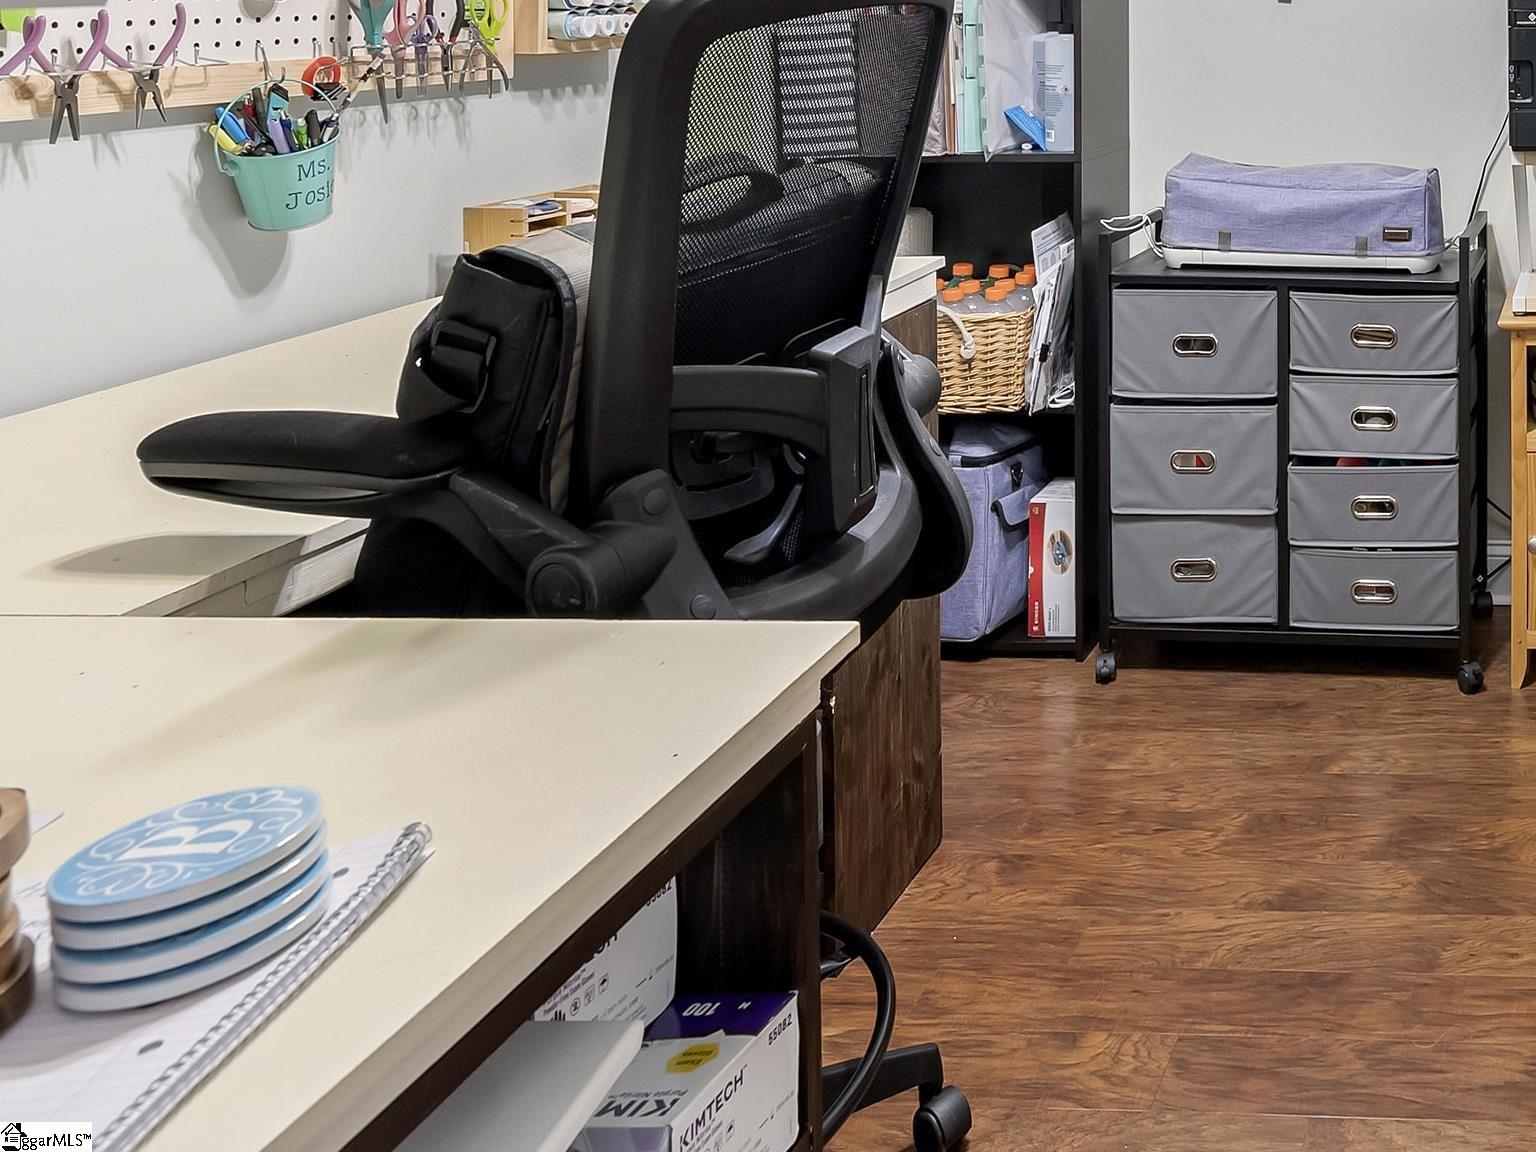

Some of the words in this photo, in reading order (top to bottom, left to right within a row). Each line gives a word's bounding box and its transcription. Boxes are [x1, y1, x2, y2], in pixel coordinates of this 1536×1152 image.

[297, 158, 330, 182] Ms.
[114, 819, 254, 862] B
[683, 1002, 721, 1017] 100
[767, 1013, 793, 1046] 55082
